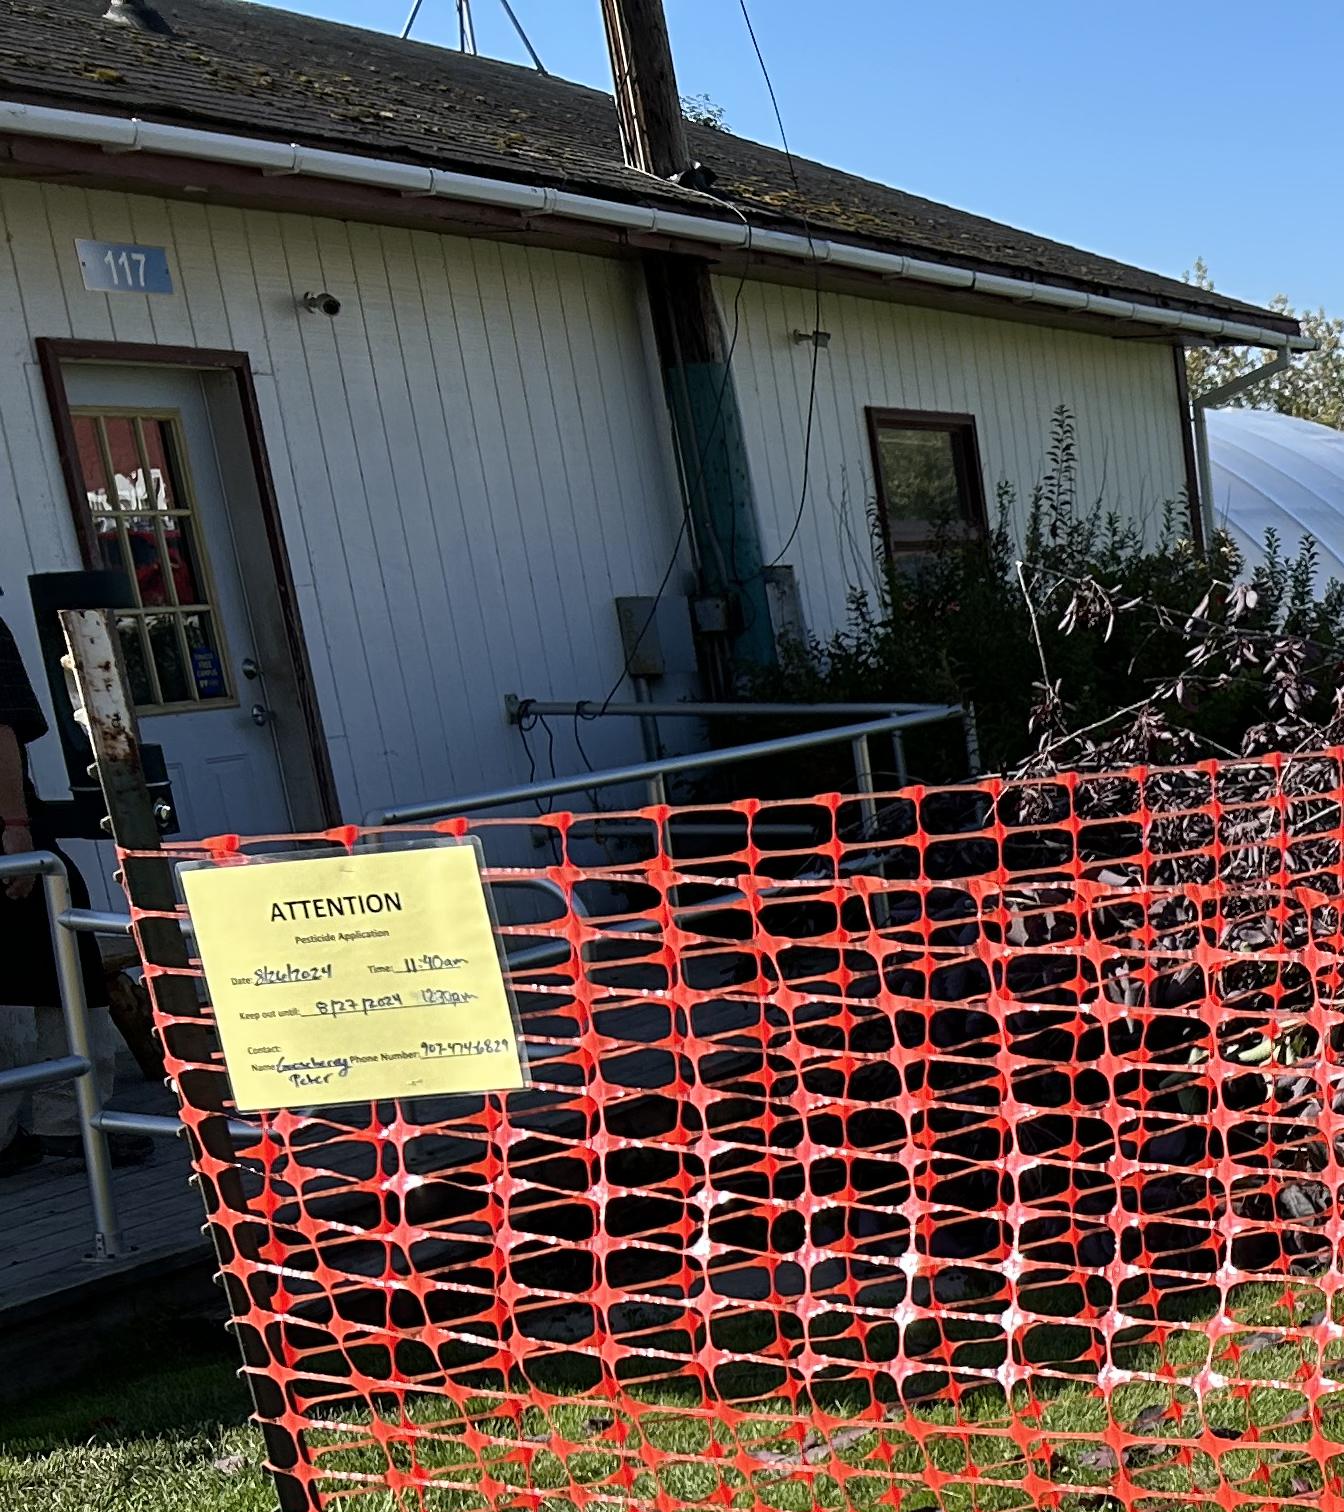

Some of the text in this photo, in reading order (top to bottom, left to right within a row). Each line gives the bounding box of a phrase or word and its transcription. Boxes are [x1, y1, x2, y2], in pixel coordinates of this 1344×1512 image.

[104, 250, 146, 287] 117
[271, 892, 402, 922] ATTENTION
[295, 929, 390, 944] Pesticide Application
[230, 976, 253, 986] Date:
[254, 963, 332, 985] 8/26/2024
[367, 964, 394, 974] Time:
[239, 1012, 260, 1021] Keep
[262, 1010, 276, 1019] out
[316, 993, 403, 1018] 8/27/2024
[350, 1053, 378, 1064] Phone
